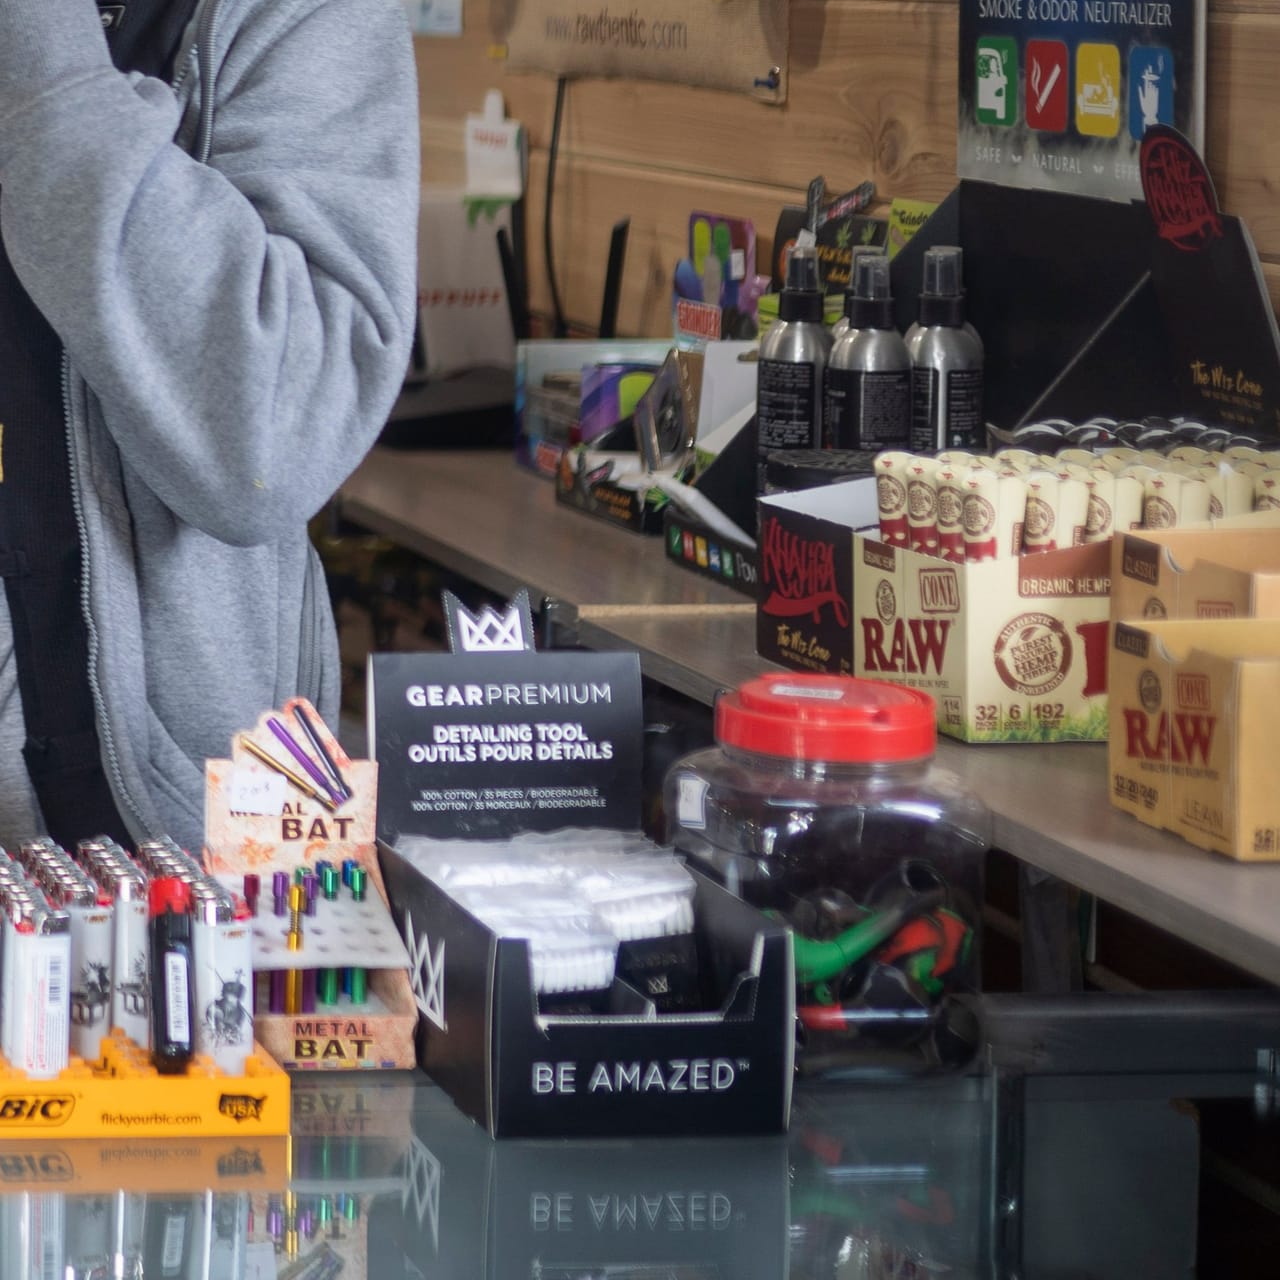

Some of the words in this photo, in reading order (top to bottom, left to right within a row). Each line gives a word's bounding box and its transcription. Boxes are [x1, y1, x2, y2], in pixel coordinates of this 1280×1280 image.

[1026, 1, 1039, 19] &
[1039, 0, 1079, 23] ODOR
[1084, 0, 1172, 27] NEUTRALIZER
[975, 146, 1001, 164] SAFE
[1032, 153, 1082, 176] NATURAL
[1190, 361, 1210, 386] The
[923, 575, 958, 608] CONE
[1022, 578, 1074, 595] ORGANIC
[1078, 578, 1112, 594] HEMP
[776, 623, 794, 647] The
[1000, 613, 1054, 646] AUTHENTIC
[861, 617, 951, 676] RAW
[1010, 634, 1054, 656] PUREST
[1014, 644, 1056, 665] NATURAL
[1014, 652, 1059, 675] HEMP
[1022, 663, 1059, 682] FIBERS
[976, 705, 999, 721] 32
[1009, 704, 1022, 721] 6
[1032, 703, 1065, 720] 192
[433, 724, 533, 744] DETAILING
[534, 723, 589, 742] TOOL
[1123, 707, 1217, 768] RAW
[408, 743, 478, 763] OUTILS
[479, 743, 534, 762] POUR
[535, 739, 614, 761] DÉTAILS
[412, 800, 433, 812] 100%
[434, 800, 468, 812] COTTON
[486, 799, 533, 810] MORCEAUX
[539, 797, 607, 809] BIODEGRADABLE
[422, 790, 443, 801] 100%
[444, 790, 478, 801] COTTON
[496, 789, 524, 800] PIECES
[531, 787, 600, 799] BIODEGRADABLE
[281, 817, 355, 842] BAT
[294, 1022, 374, 1037] METAL
[294, 1039, 373, 1059] BAT
[533, 1062, 577, 1093] BE
[100, 1113, 202, 1128] flickyourbic.com
[229, 1104, 256, 1118] USA
